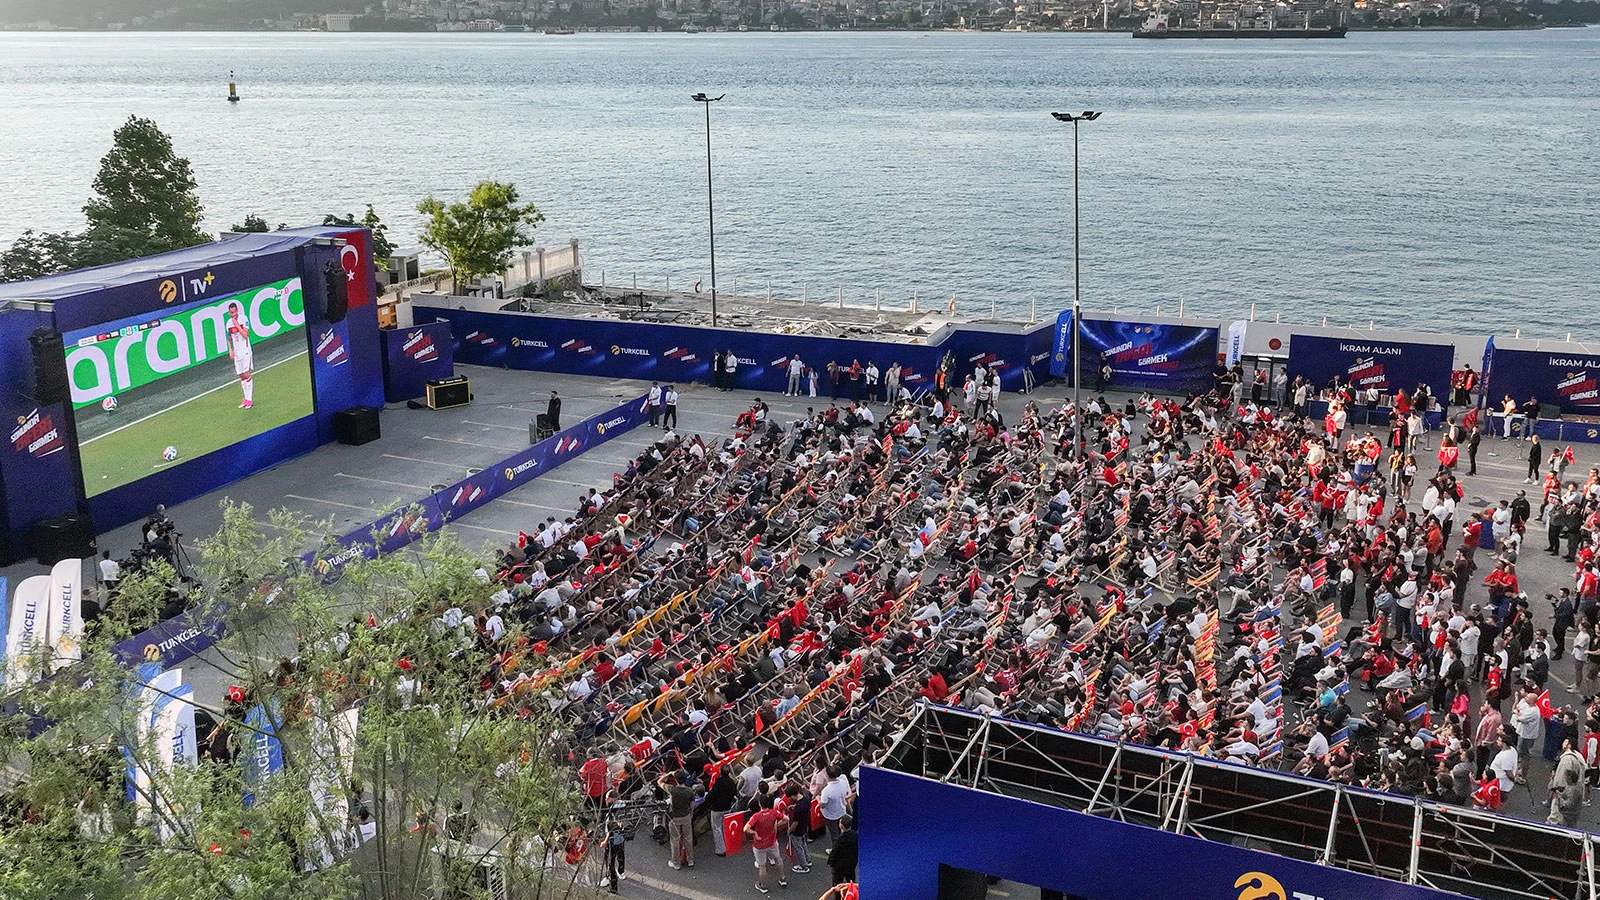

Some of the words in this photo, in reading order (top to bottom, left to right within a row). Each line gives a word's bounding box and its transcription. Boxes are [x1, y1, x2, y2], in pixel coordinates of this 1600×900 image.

[520, 339, 548, 348] TURKCELL
[1340, 342, 1371, 353] İKRAM
[1371, 346, 1402, 356] ALANI
[620, 347, 650, 356] TURKCELL
[1549, 356, 1583, 367] İKRAM
[604, 415, 626, 430] TURKCELL
[513, 458, 538, 475] TURKCELL
